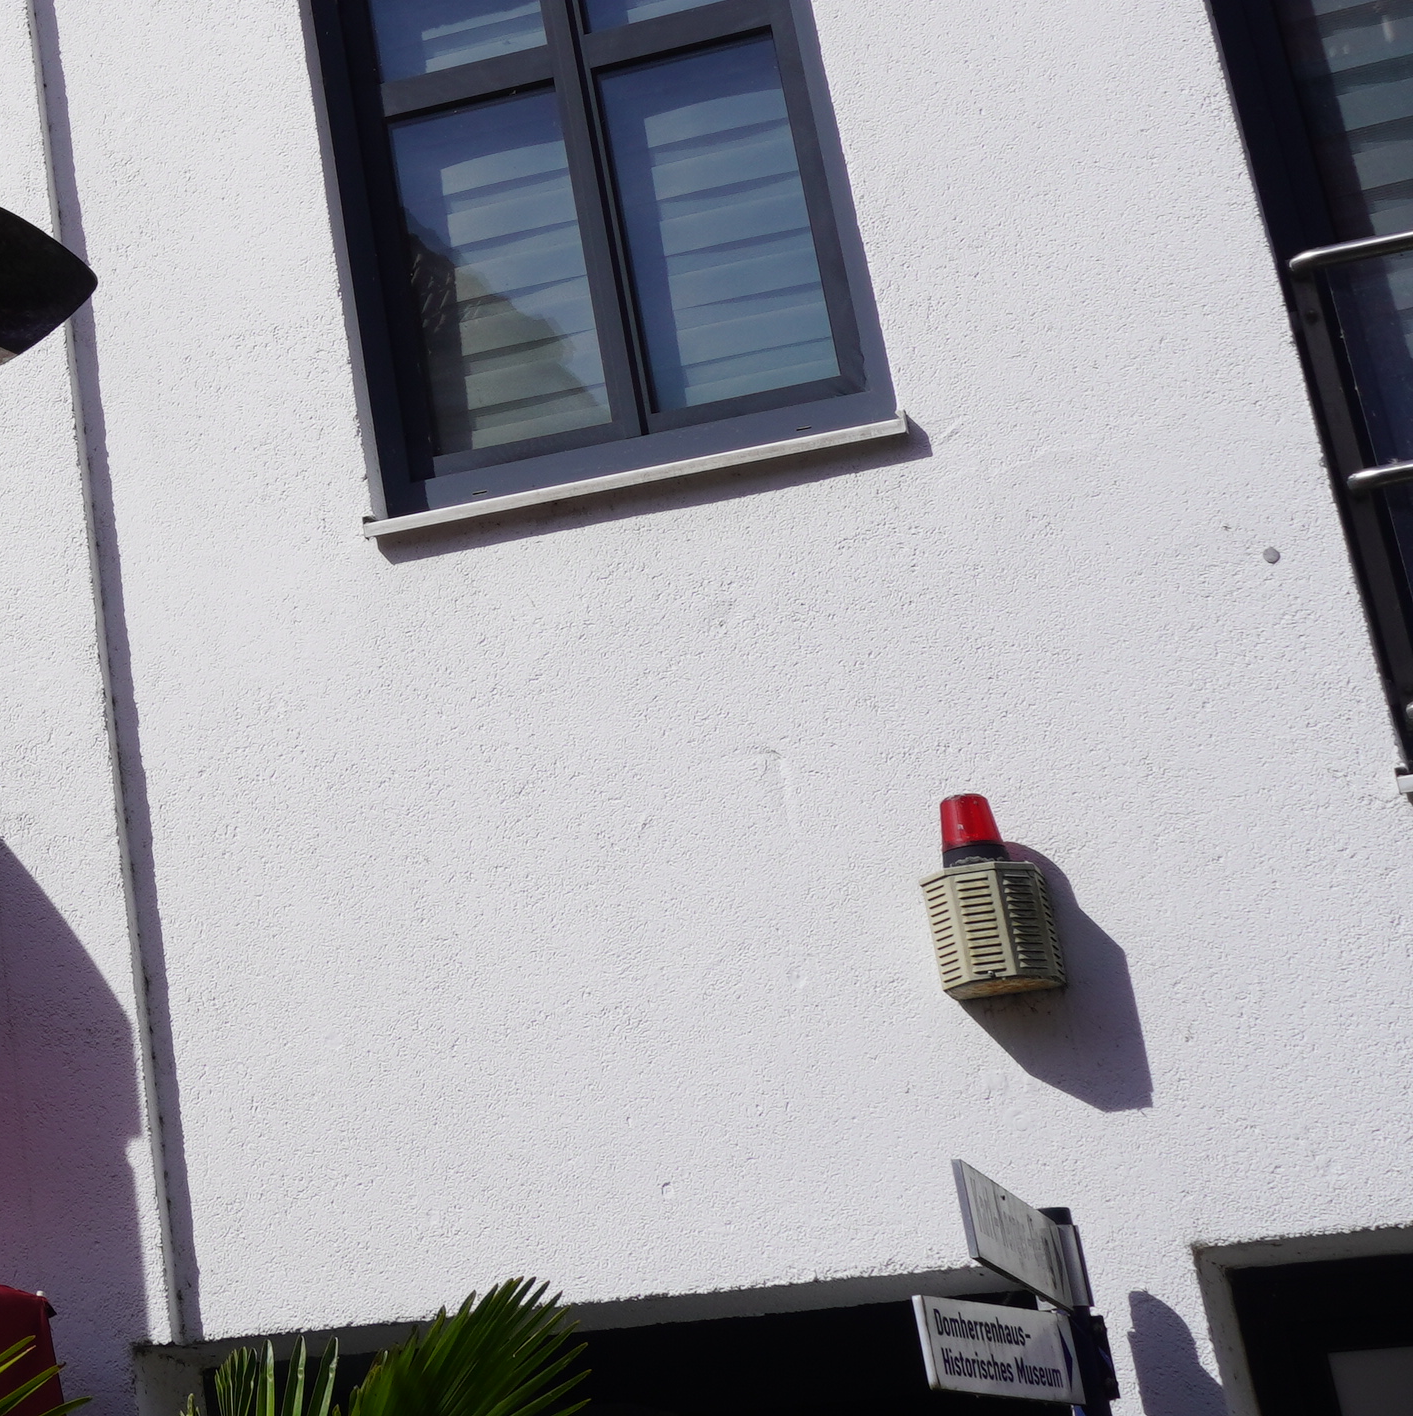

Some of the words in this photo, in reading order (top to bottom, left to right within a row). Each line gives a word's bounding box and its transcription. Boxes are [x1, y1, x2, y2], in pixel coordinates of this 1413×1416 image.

[933, 1309, 1030, 1346] Domherrenhaus-
[941, 1347, 1014, 1383] Historisches
[1014, 1357, 1064, 1388] Museum
